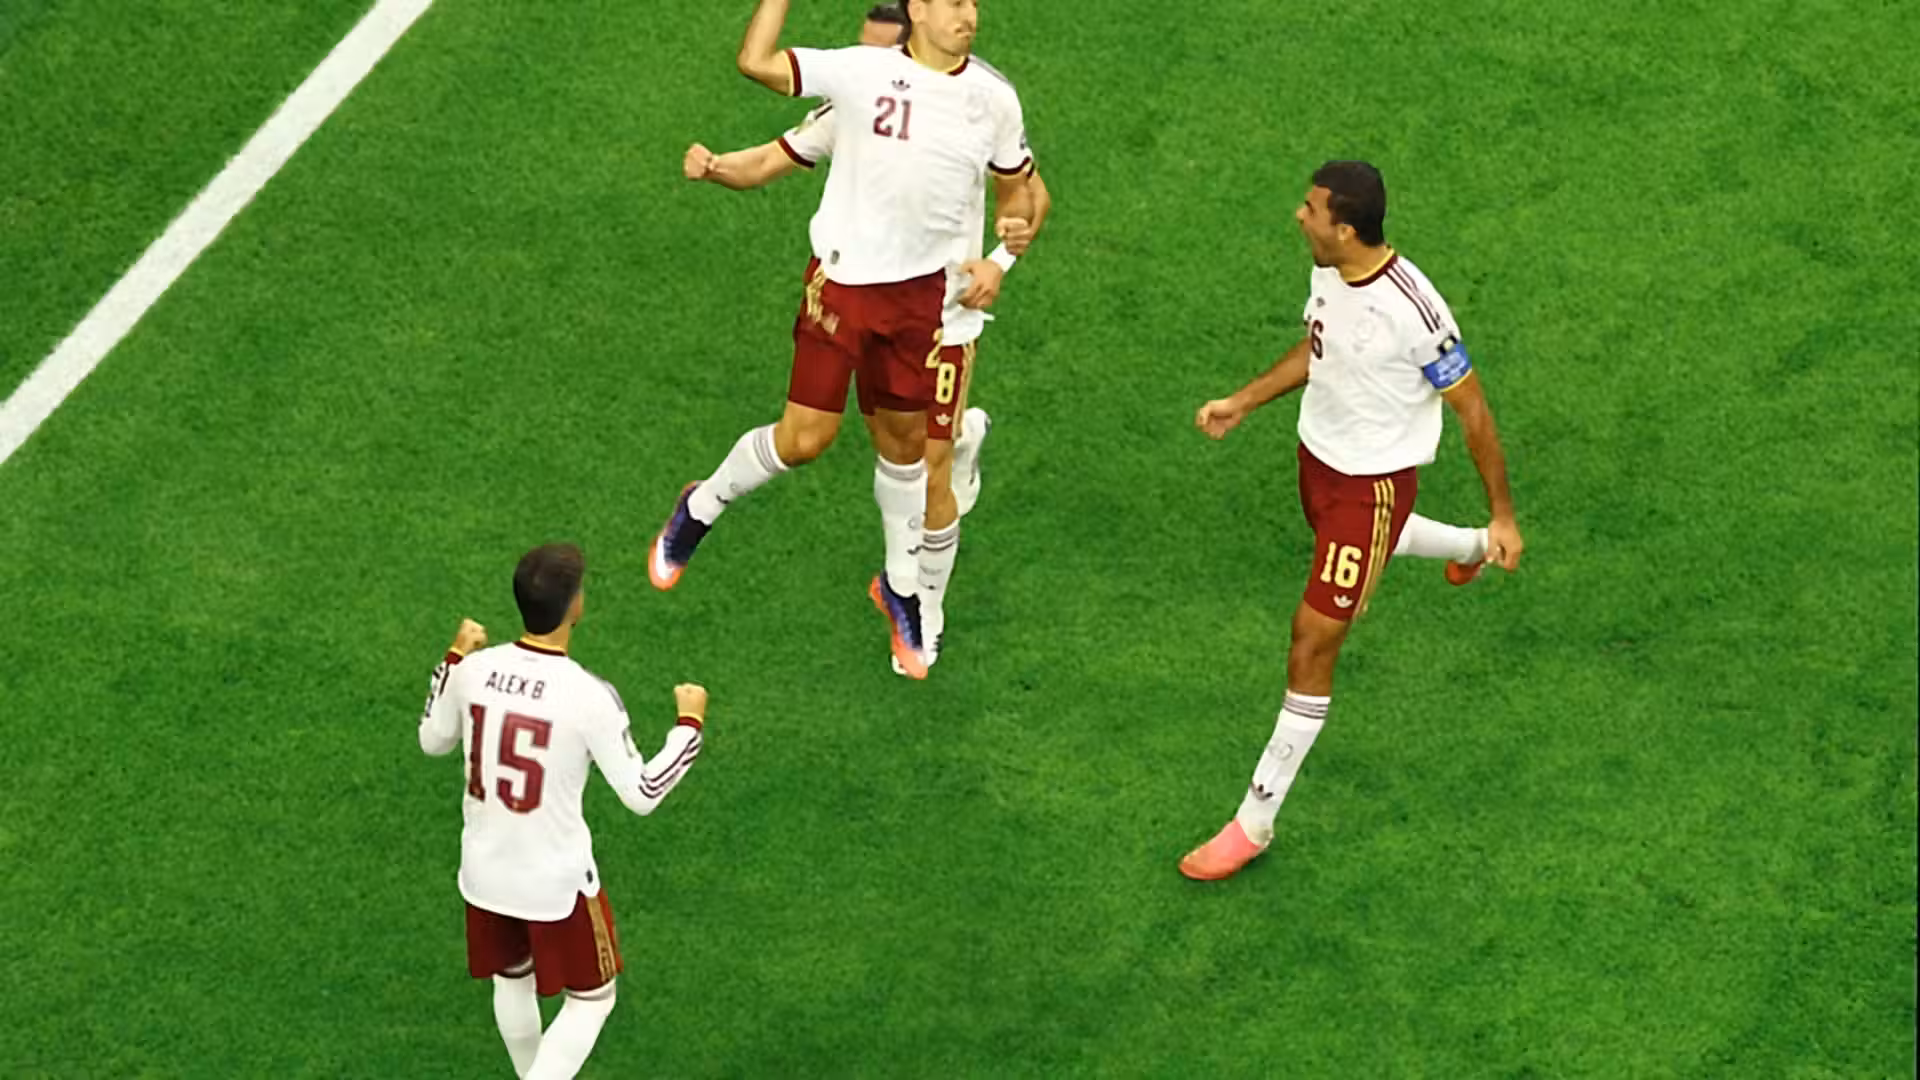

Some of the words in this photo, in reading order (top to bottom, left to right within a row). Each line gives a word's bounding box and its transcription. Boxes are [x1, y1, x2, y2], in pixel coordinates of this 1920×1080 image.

[873, 96, 911, 140] 21
[936, 362, 957, 404] 8
[1320, 541, 1362, 588] 16
[485, 671, 528, 696] ALEX
[469, 704, 552, 814] 15
